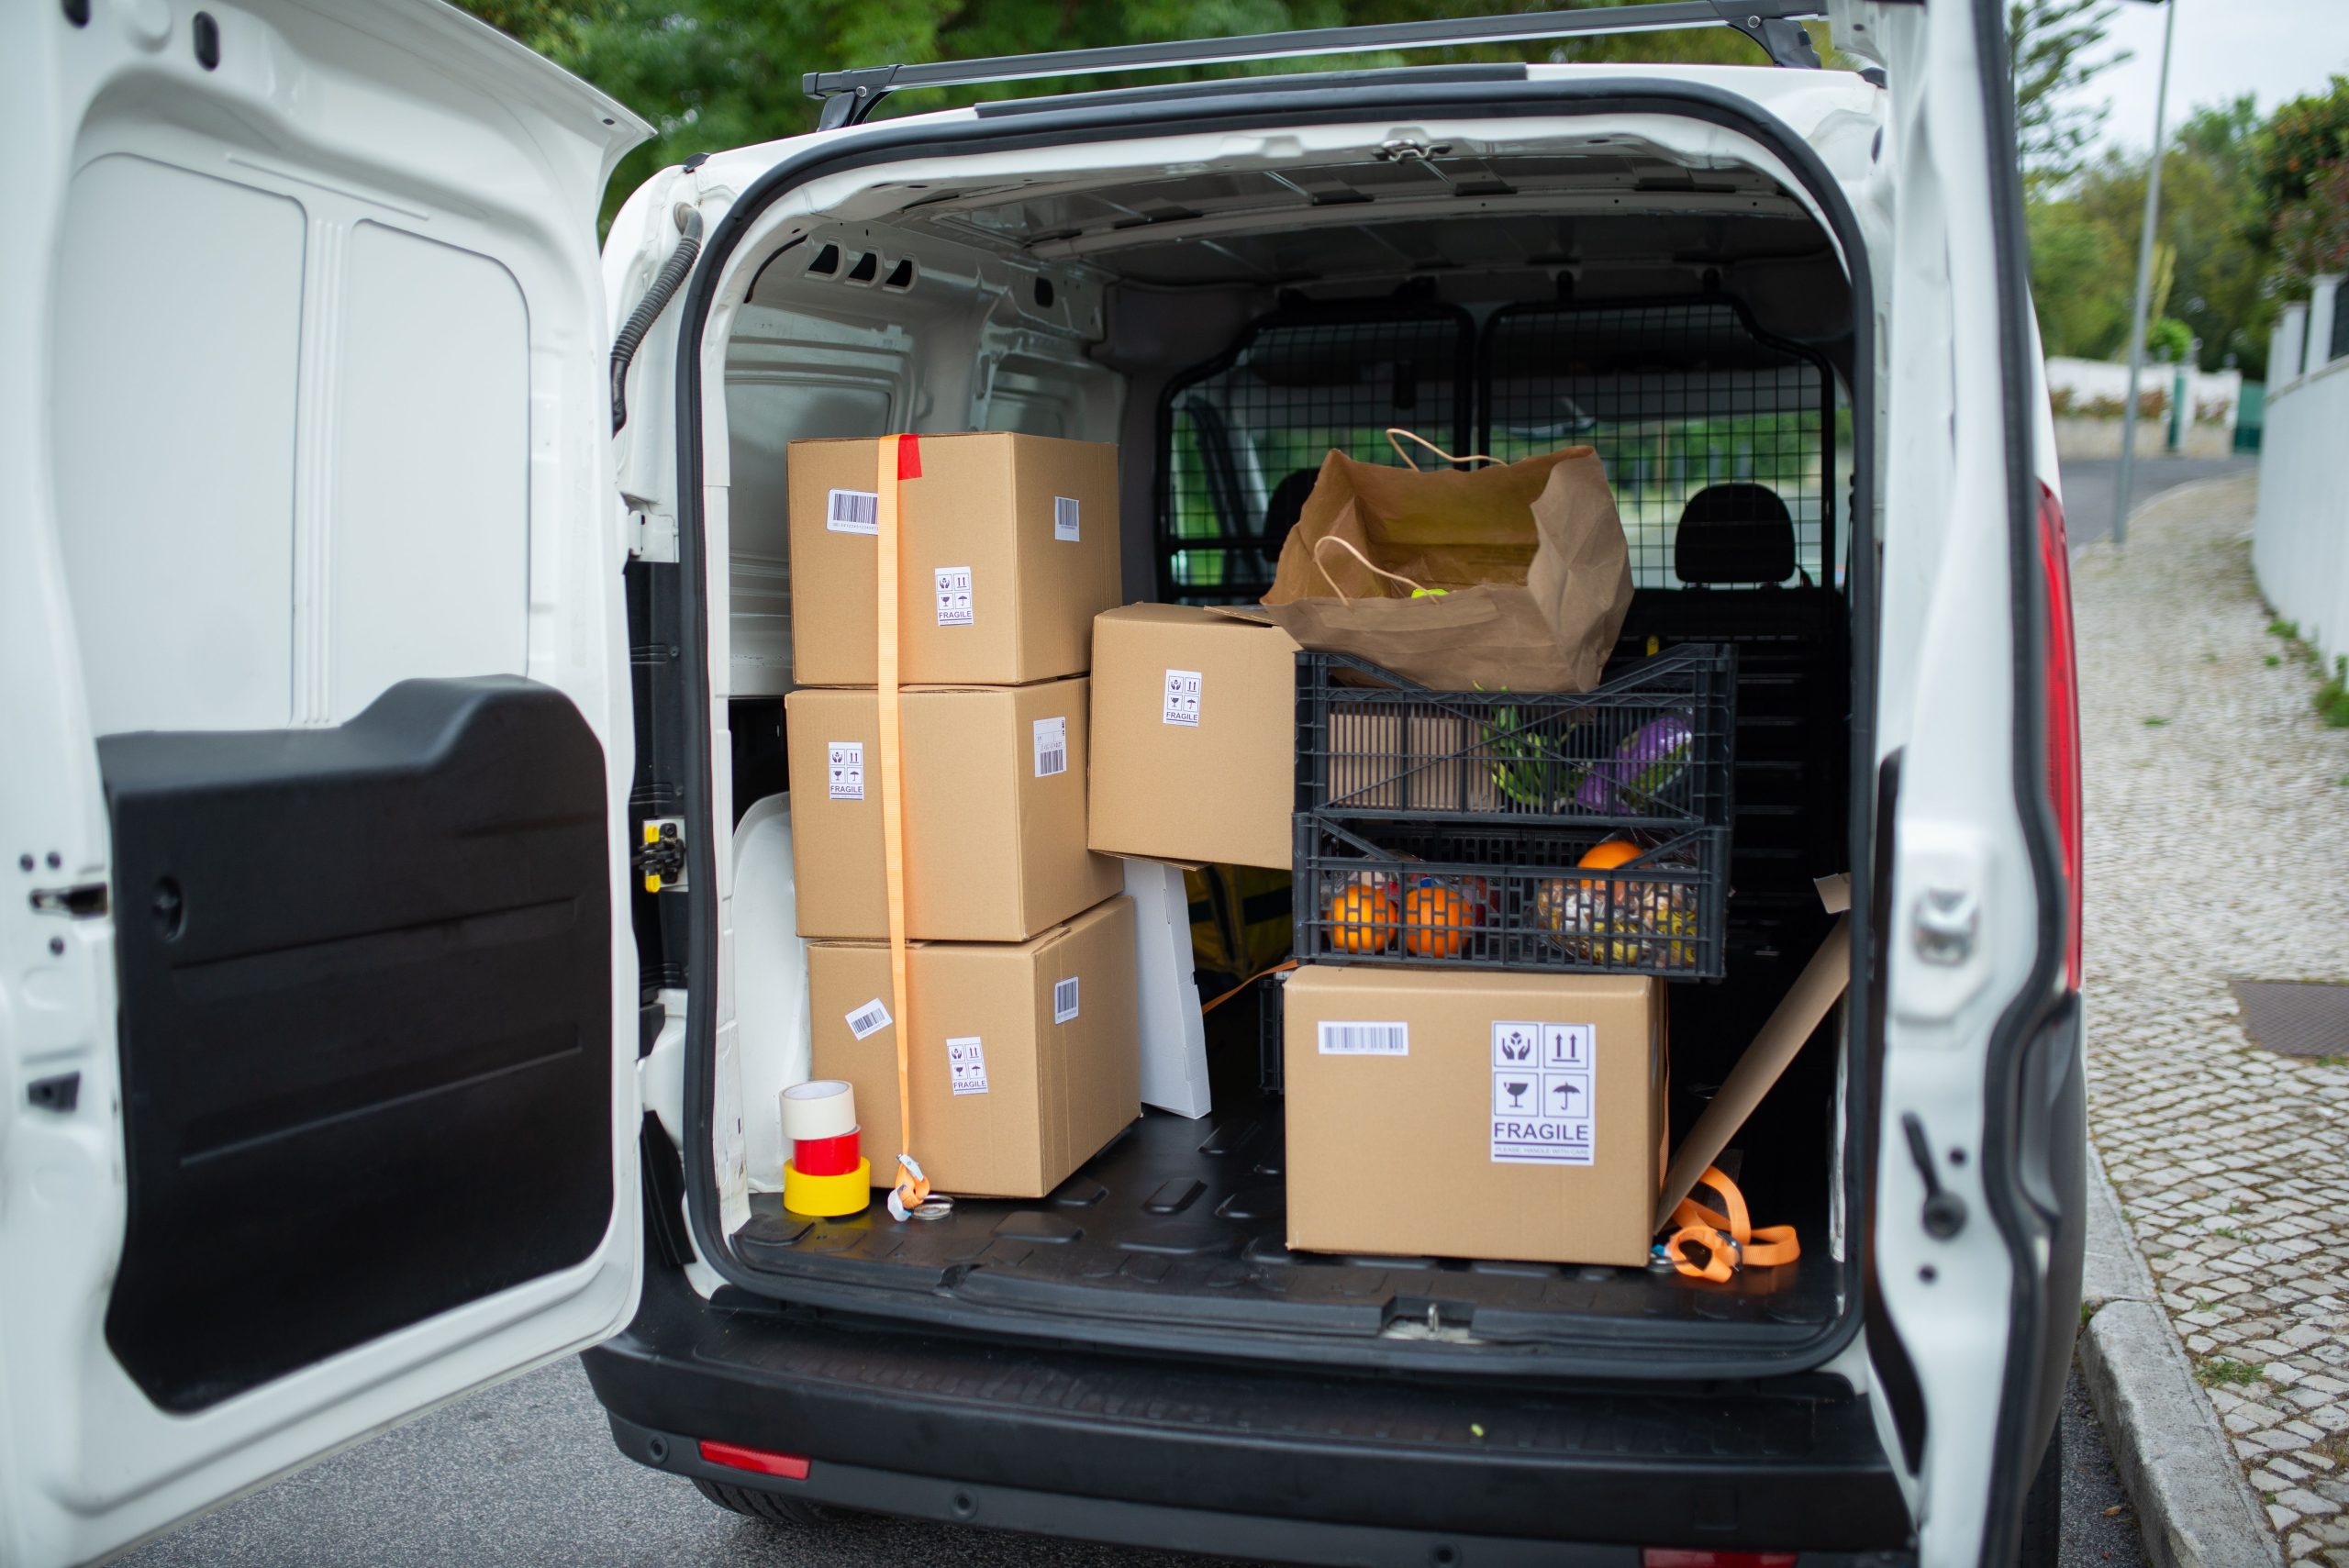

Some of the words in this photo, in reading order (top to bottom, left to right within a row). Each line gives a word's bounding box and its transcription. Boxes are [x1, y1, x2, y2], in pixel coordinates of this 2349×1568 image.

[939, 610, 972, 618] FRAGILE
[1166, 711, 1197, 720] FRAGILE
[953, 1080, 986, 1088] FRAGILE
[1494, 1122, 1589, 1140] FRAGILE
